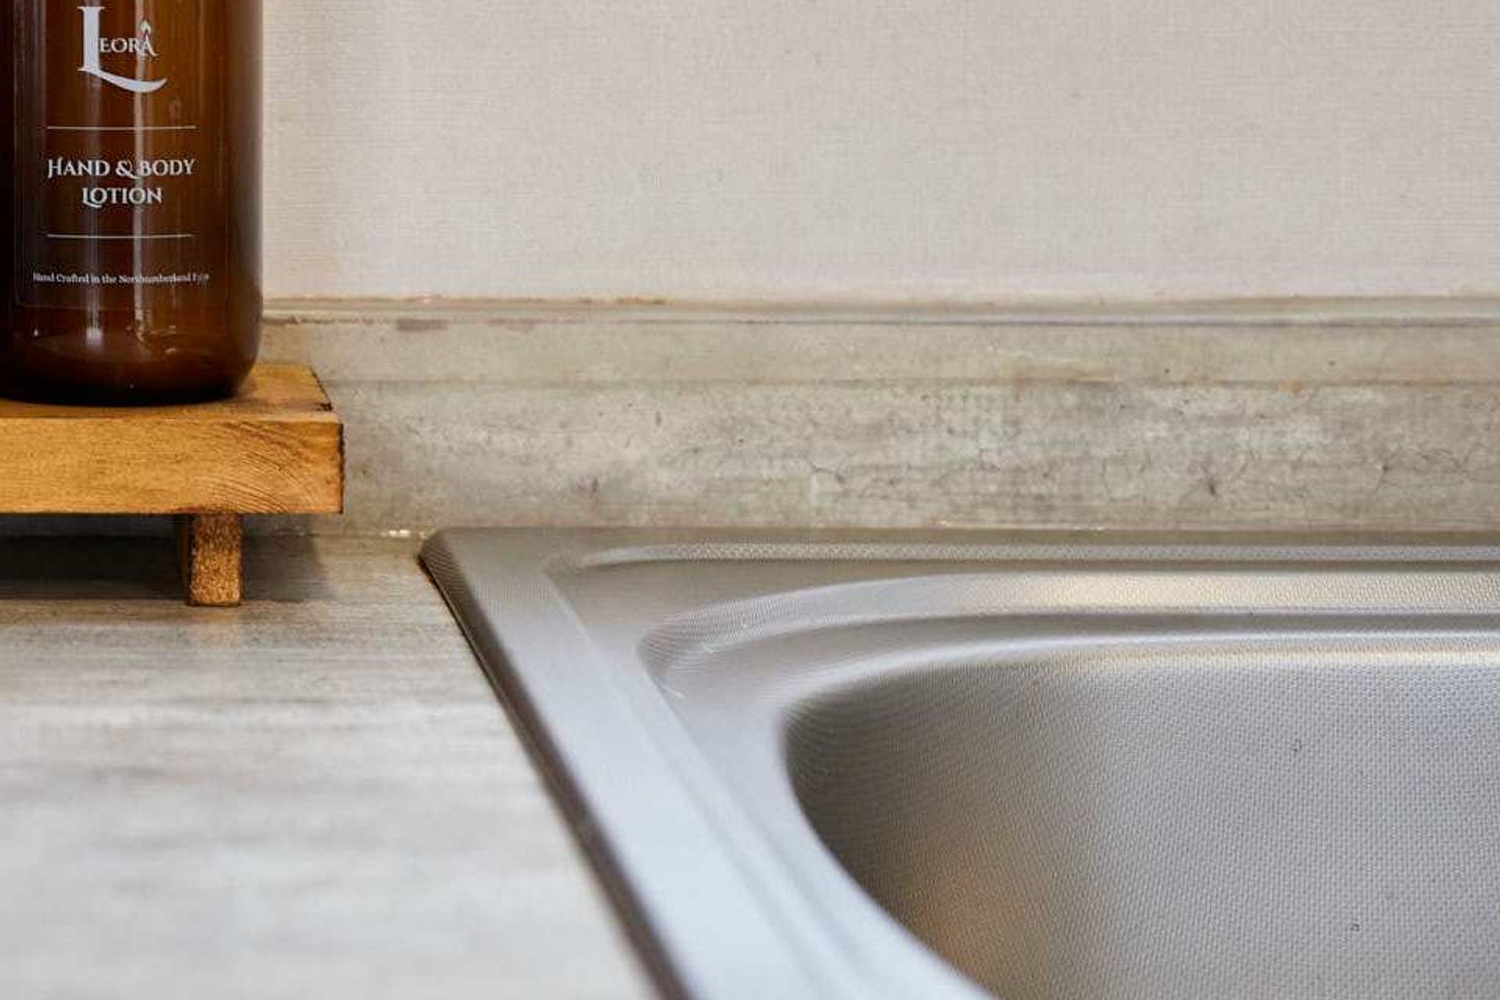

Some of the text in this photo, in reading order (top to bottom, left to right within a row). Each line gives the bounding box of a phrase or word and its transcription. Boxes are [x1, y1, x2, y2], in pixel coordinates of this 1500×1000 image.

[115, 159, 140, 180] &
[139, 158, 195, 177] BODY
[82, 186, 163, 209] LOTION
[33, 271, 55, 283] Hand
[56, 272, 89, 284] Crafted
[90, 272, 100, 284] in
[101, 273, 117, 284] the
